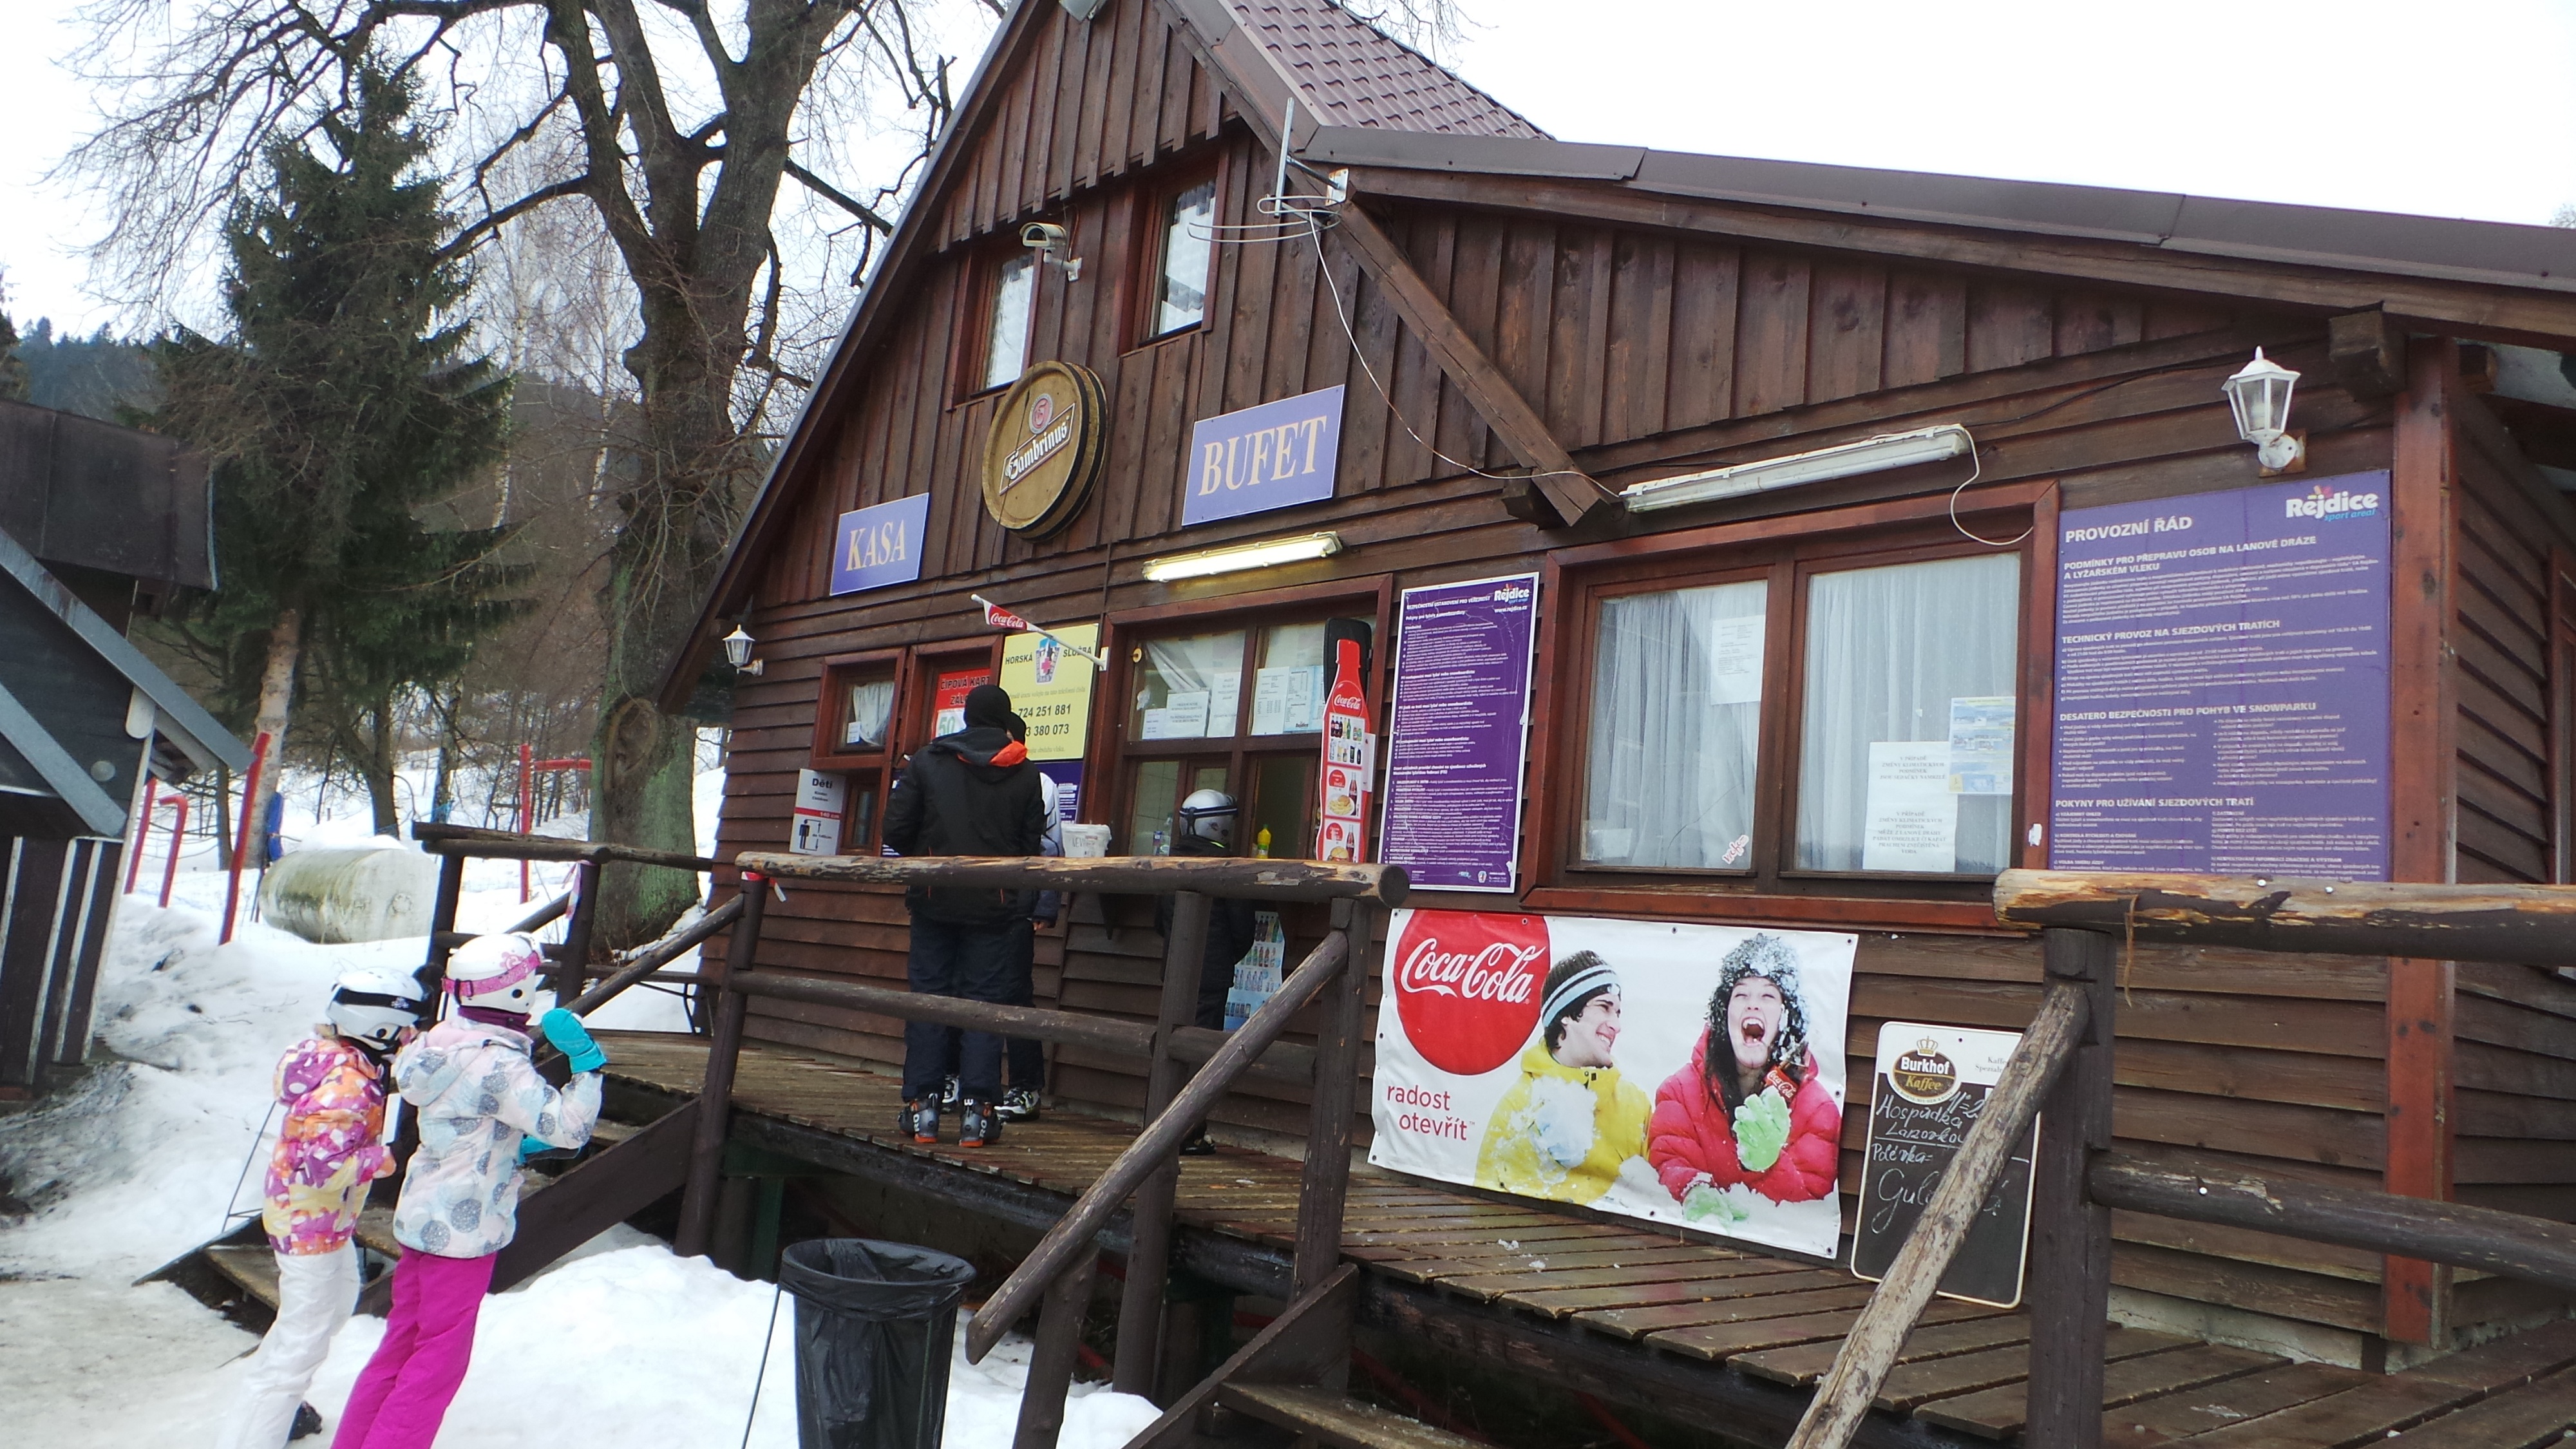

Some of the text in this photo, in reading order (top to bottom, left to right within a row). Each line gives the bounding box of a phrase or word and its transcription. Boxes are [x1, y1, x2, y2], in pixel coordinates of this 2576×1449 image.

[1005, 421, 1068, 480] Gambrinus
[1198, 415, 1327, 496] BUFET
[2286, 491, 2378, 519] Rejdice
[2324, 508, 2376, 522] sport areal
[2065, 515, 2193, 543] PROVOZNÍ ŘÁD
[845, 519, 906, 571] KASA
[2064, 536, 2316, 571] PODMÍNKY PRO PŘEPRAVU OSOB NA LANOVÉ DRÁZE
[2073, 565, 2126, 578] LYŽAŘSKÉM
[2129, 563, 2160, 573] VLEKU
[1493, 587, 1530, 603] Rejdice
[990, 612, 1024, 629] Coca-Cola
[2062, 620, 2280, 644] TECHNICKÝ PROVOZ NA SJEZDOVÝCH TRATÍCH
[1005, 652, 1033, 665] HORSKÁ
[940, 676, 967, 690] ČIPOVÁ
[1019, 703, 1071, 718] 724 251 881
[1334, 694, 1361, 710] Coca-Cola
[2060, 702, 2316, 721] DESATERO BEZPEČNOSTI PRO POHYB VE SNOWPARKU
[1034, 725, 1050, 736] 380
[1052, 724, 1069, 735] 073
[812, 778, 833, 789] Děti
[2056, 796, 2254, 808] POKYNY PRO UŽÍVÁNÍ SJEZDOVÝCH TRATÍ
[1401, 938, 1546, 1005] Coca-Cola
[1900, 1056, 1950, 1075] Burkhof
[1987, 1056, 2008, 1065] Kaffe
[1767, 1070, 1797, 1098] Coca-Cola
[1906, 1075, 1942, 1092] Kaffee
[1387, 1083, 1450, 1111] radost
[1876, 1094, 1963, 1130] Hospůdka
[1399, 1112, 1469, 1142] otevřít
